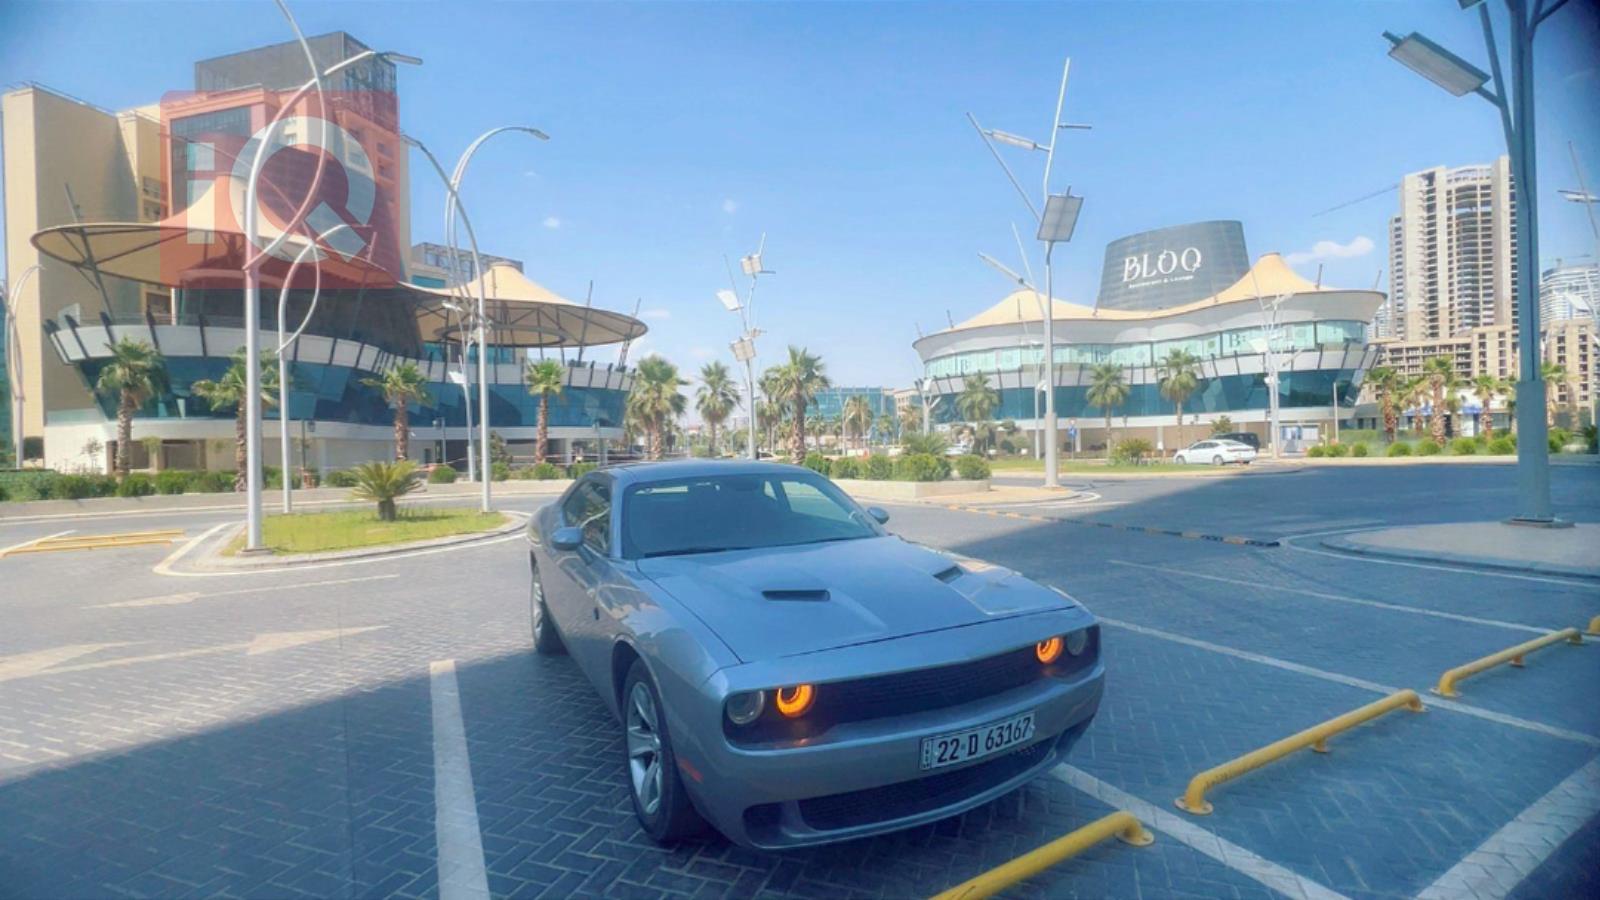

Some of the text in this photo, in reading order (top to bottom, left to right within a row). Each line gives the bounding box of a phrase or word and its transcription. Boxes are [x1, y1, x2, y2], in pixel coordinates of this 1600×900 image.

[1122, 247, 1202, 282] BLOQ
[937, 738, 960, 763] 22
[967, 733, 978, 757] D
[985, 716, 1031, 751] 63167
